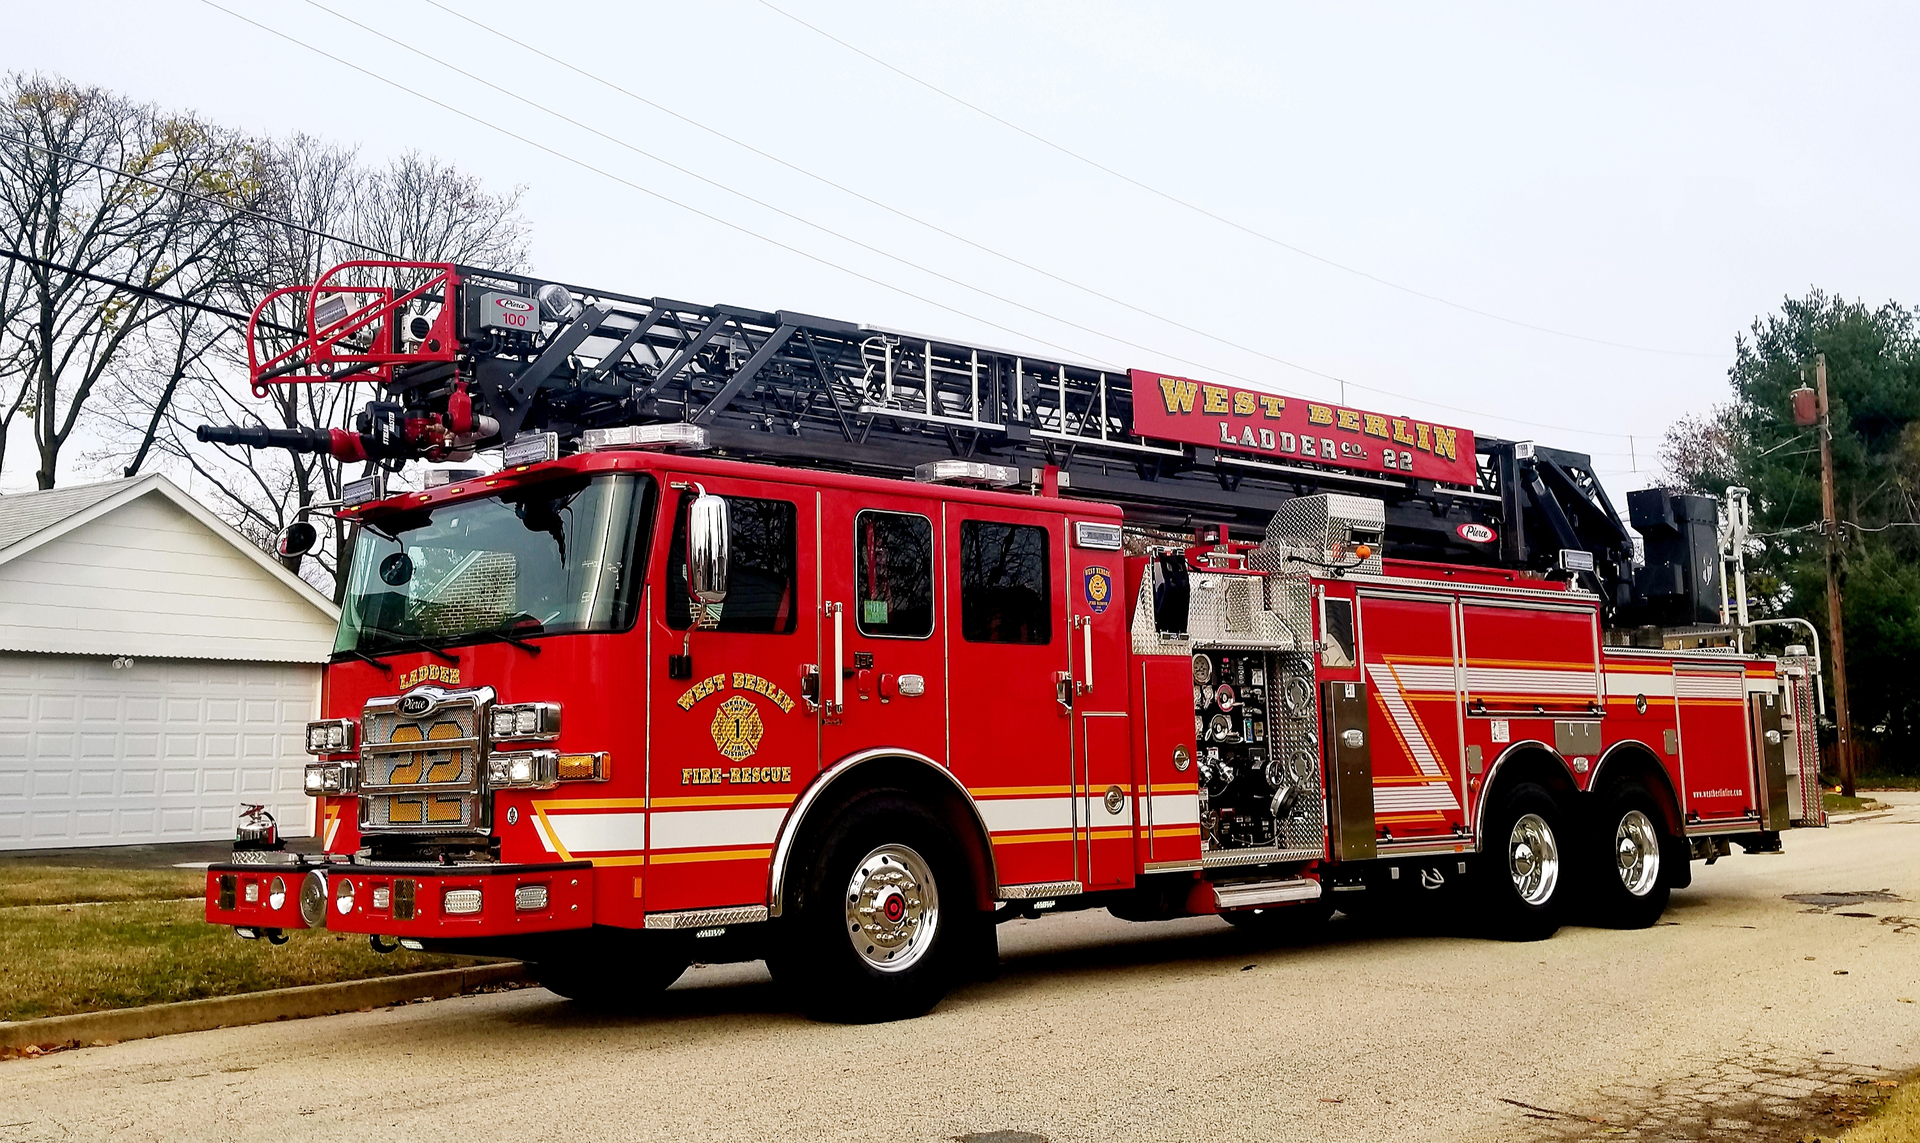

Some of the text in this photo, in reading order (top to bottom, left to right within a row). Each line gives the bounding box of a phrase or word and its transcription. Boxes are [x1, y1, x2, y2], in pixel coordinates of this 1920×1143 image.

[504, 299, 526, 309] Pierce
[503, 312, 529, 327] 100'
[1158, 377, 1457, 462] WEST BERLIN
[1219, 421, 1337, 460] LADDER
[1383, 449, 1413, 472] 22
[1465, 525, 1490, 539] Pierce
[399, 664, 460, 690] LADDER
[677, 672, 796, 714] WEST BERLIN
[402, 697, 426, 712] Pierce
[724, 700, 751, 709] BERLIN
[734, 718, 740, 739] 1
[723, 749, 752, 757] DISTRICT
[388, 721, 463, 823] 22
[682, 767, 791, 783] FIRE-RESCUE
